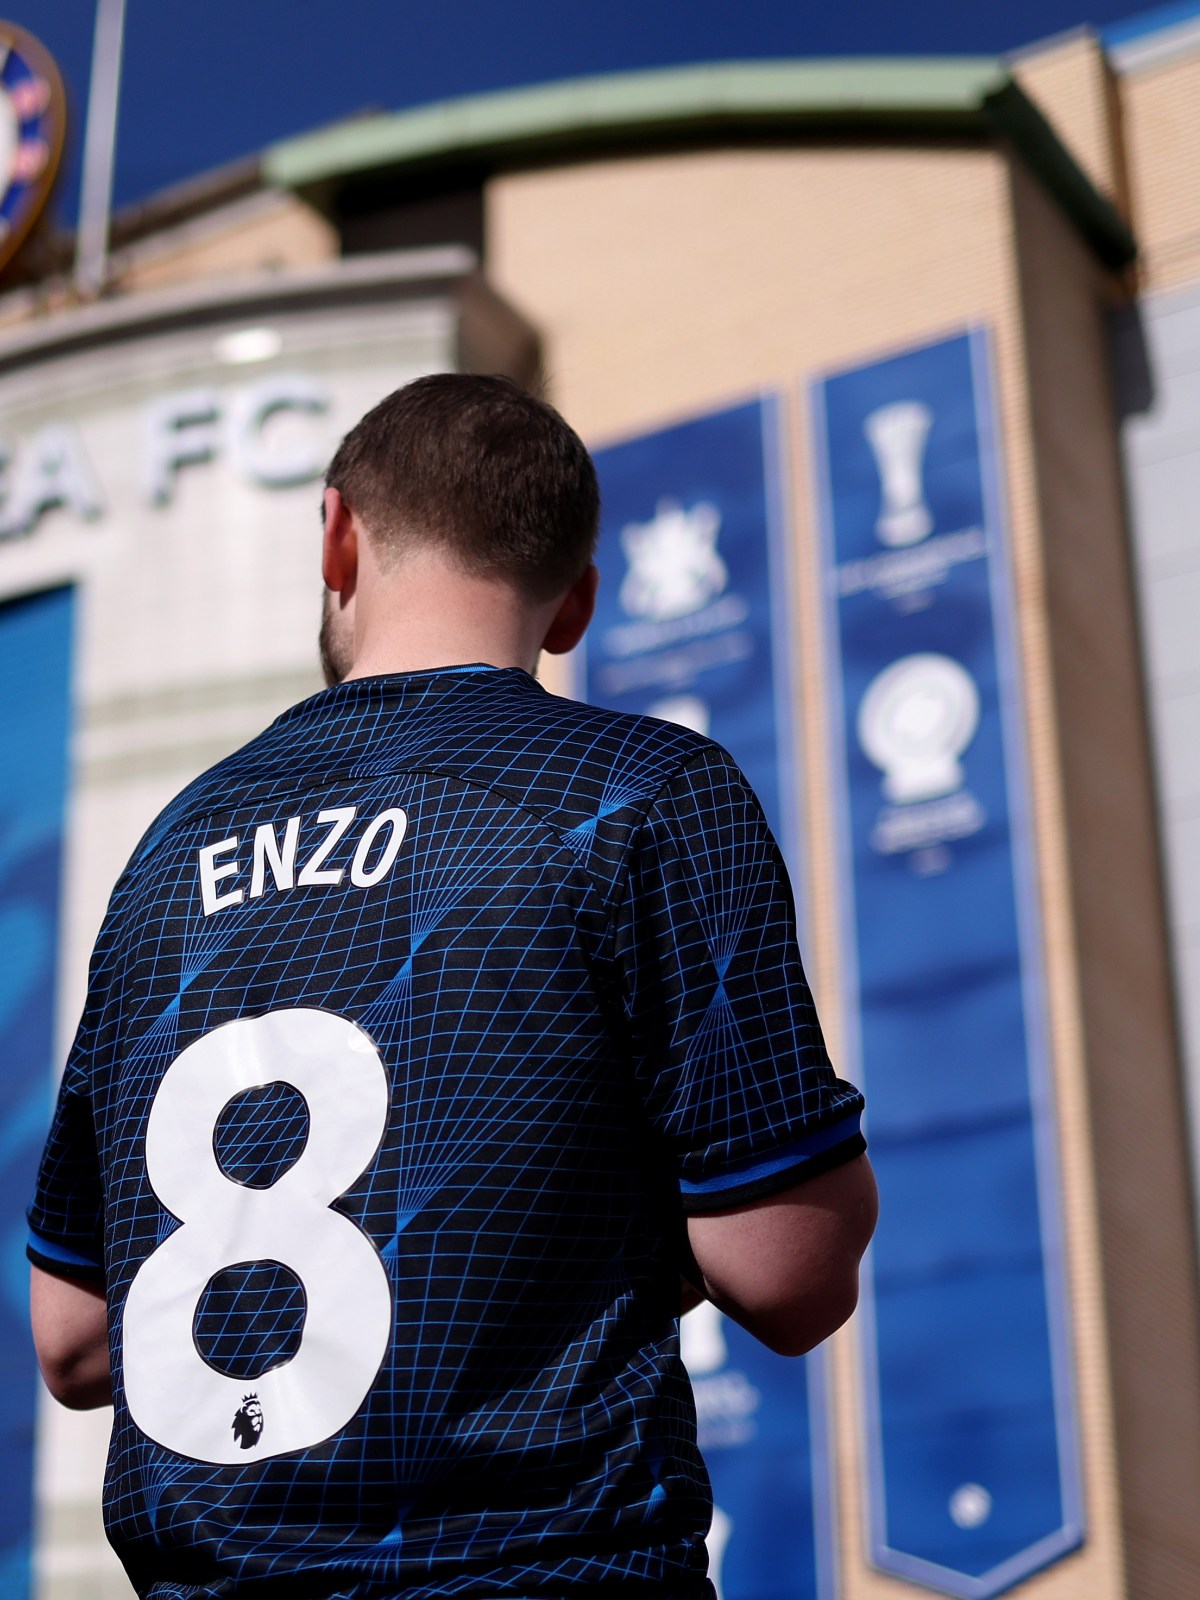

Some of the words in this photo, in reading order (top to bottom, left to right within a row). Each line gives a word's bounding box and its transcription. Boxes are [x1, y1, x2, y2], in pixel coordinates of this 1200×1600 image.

[146, 374, 330, 506] FC
[199, 805, 408, 917] ENZO
[122, 1006, 393, 1466] 8
